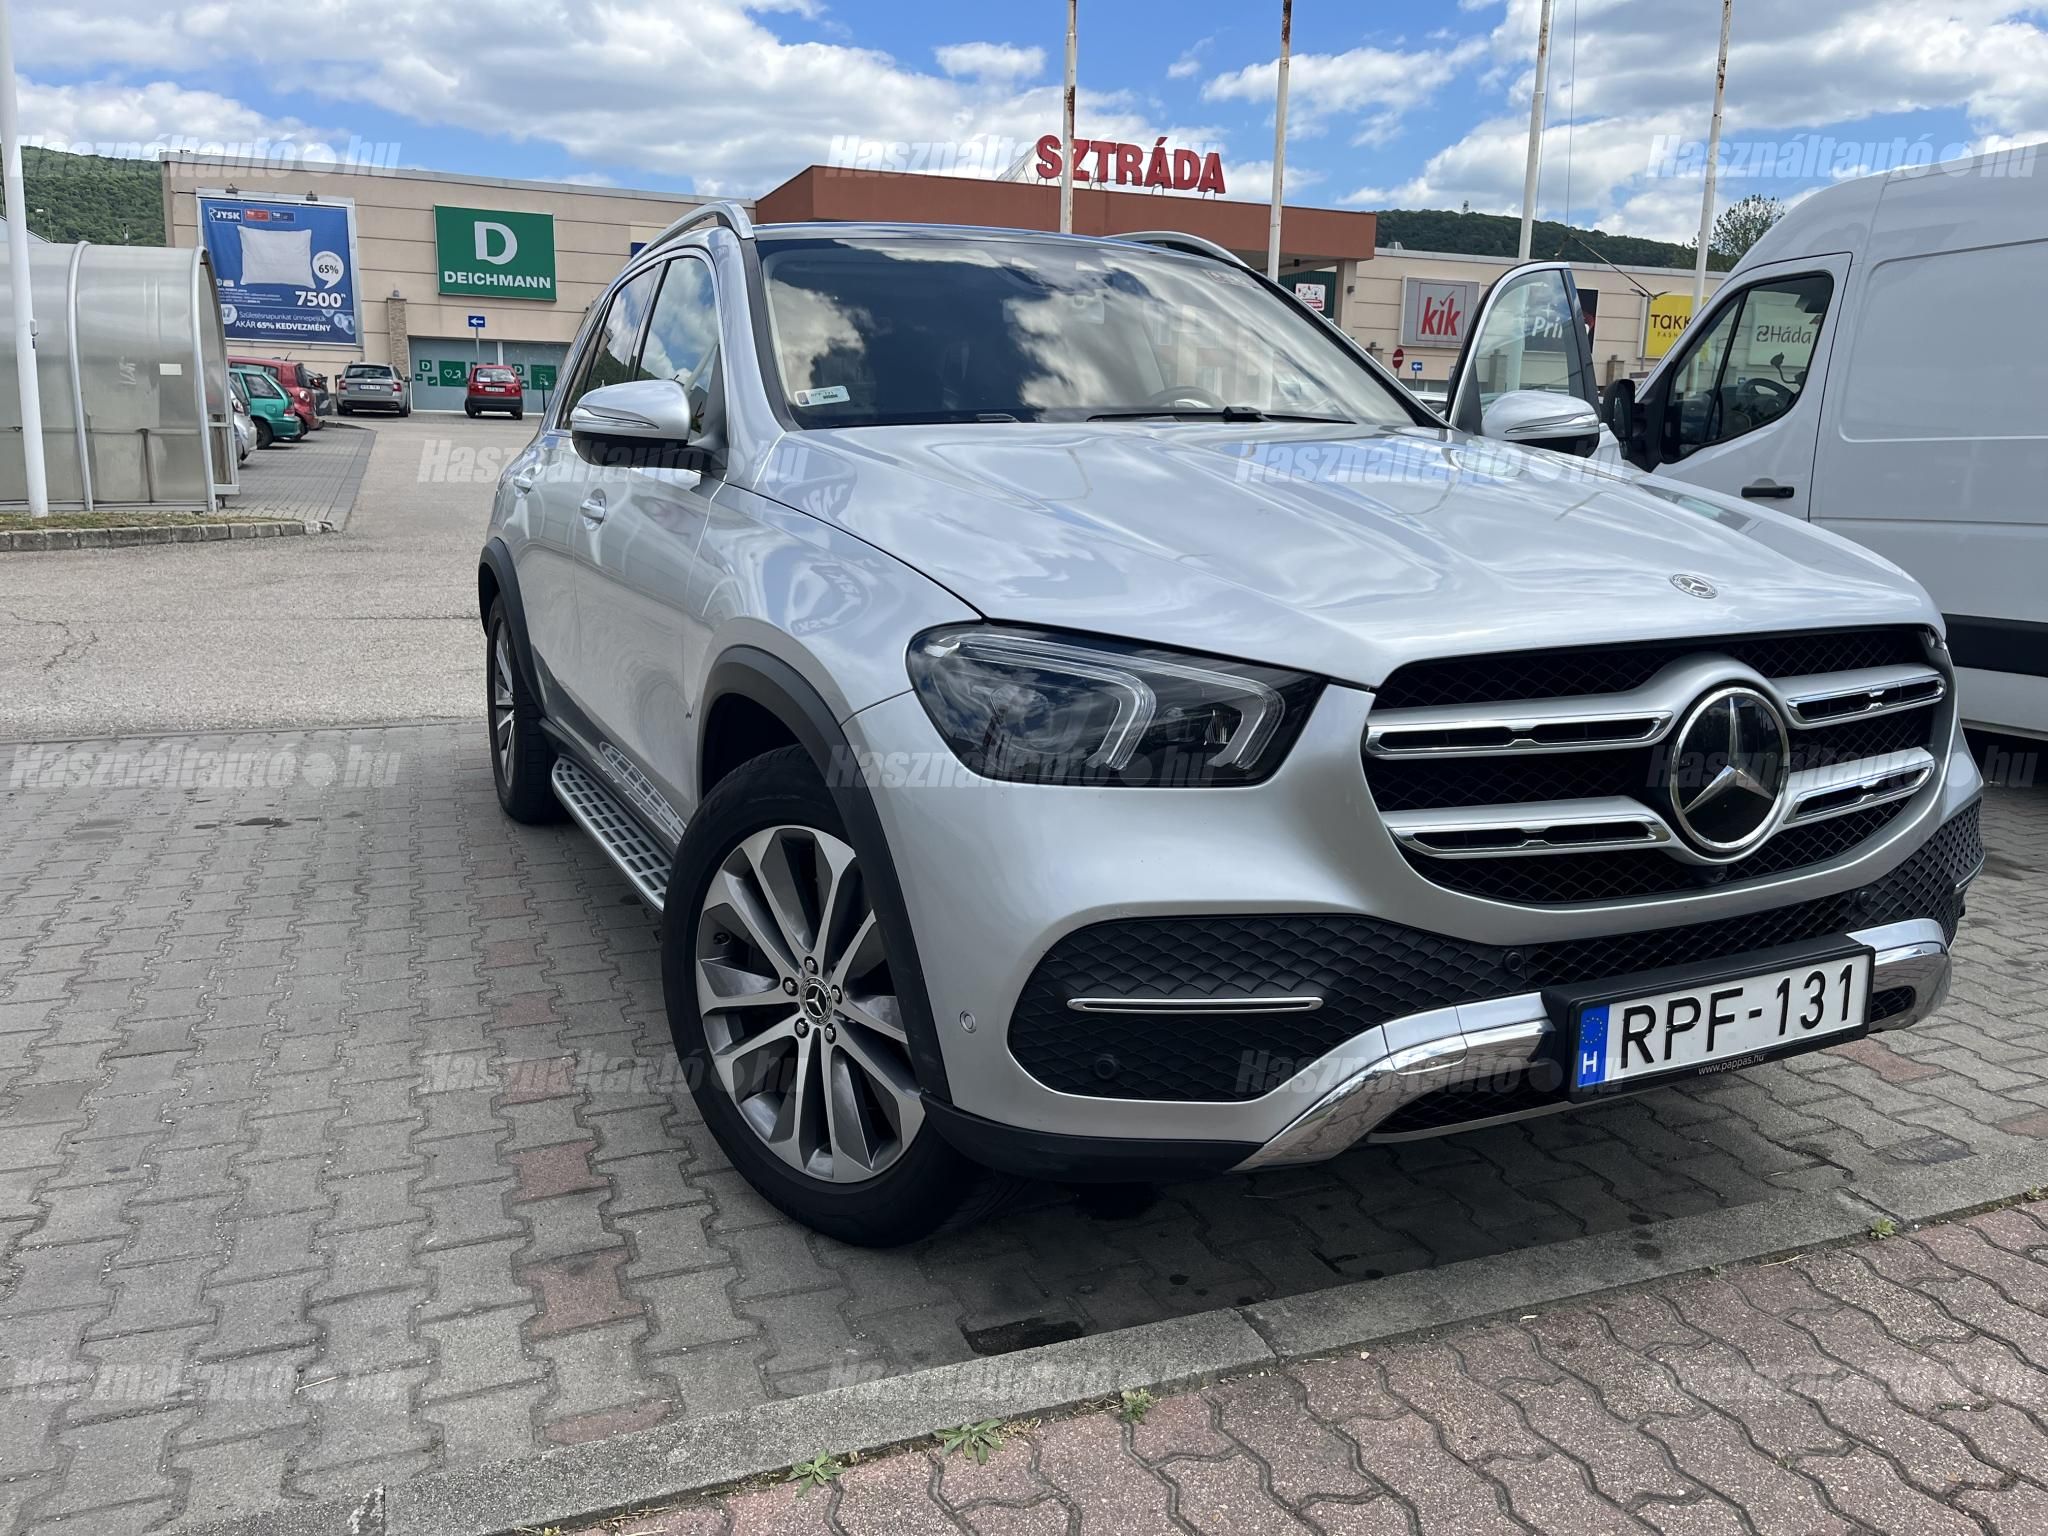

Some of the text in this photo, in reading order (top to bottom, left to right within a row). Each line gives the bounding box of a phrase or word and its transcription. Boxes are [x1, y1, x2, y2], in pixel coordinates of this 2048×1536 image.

[1035, 135, 1226, 194] SZTRÁDA
[216, 210, 241, 220] JYSK
[318, 265, 339, 275] 65%
[444, 271, 551, 289] DEICHMANN
[295, 291, 342, 308] 7500
[1421, 291, 1461, 336] kik
[275, 323, 331, 332] KEDVEZMÉNY
[1770, 325, 1812, 344] Háda
[1620, 963, 1855, 1069] RPF-131
[1582, 1050, 1598, 1076] H
[1697, 1053, 1765, 1076] www.pappas.hu
